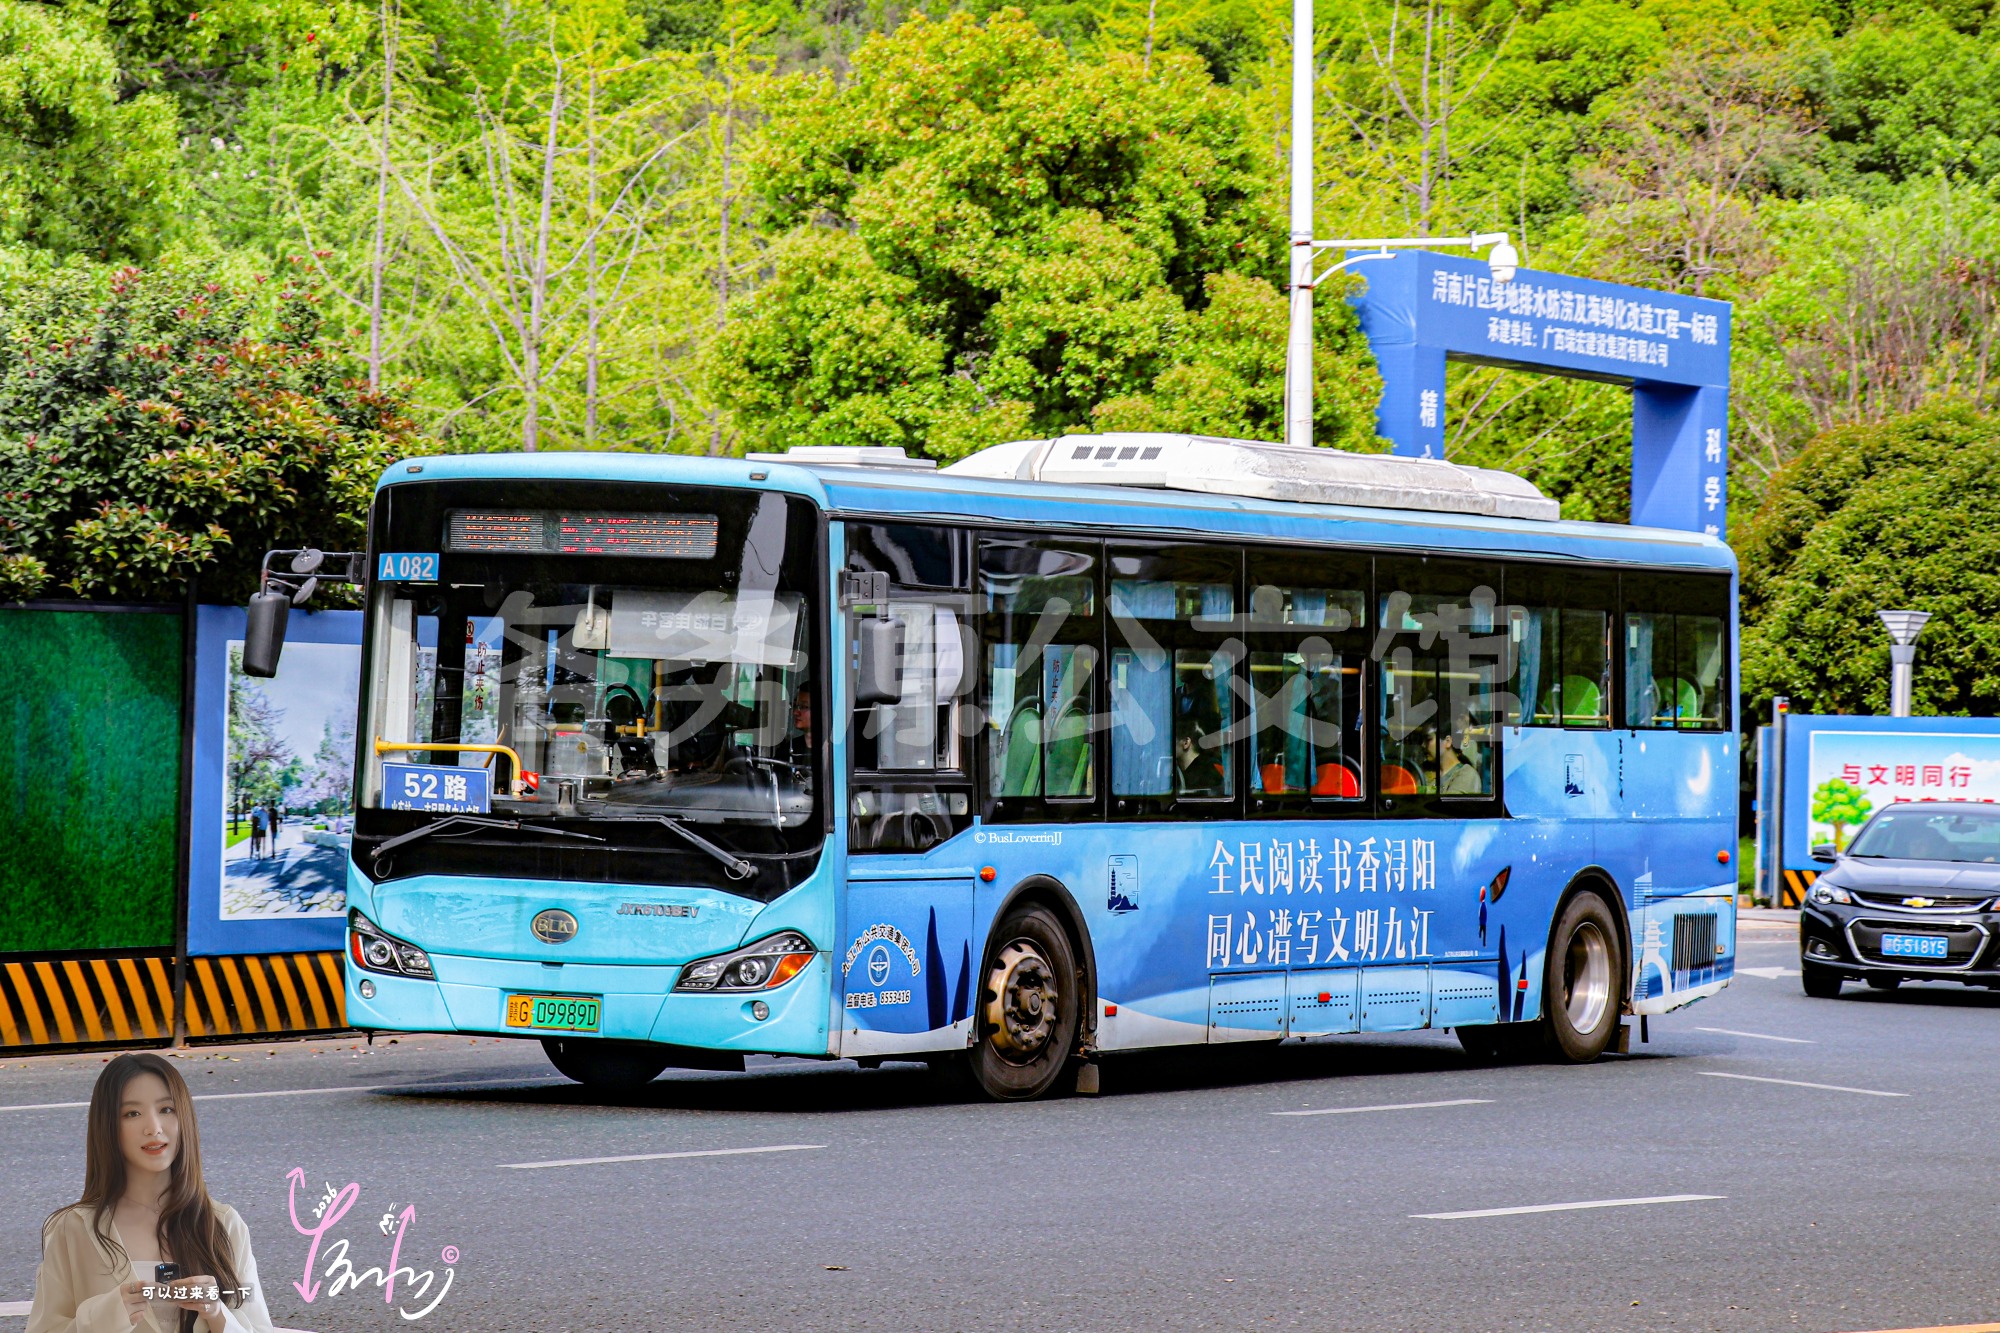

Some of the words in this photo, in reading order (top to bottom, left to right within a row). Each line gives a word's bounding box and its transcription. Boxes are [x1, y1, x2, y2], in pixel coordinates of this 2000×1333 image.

[400, 556, 434, 578] 082
[404, 772, 438, 799] 52
[443, 774, 467, 801] 路
[1841, 763, 1972, 787] 与文明同行
[1208, 836, 1436, 896] 全民阅读书香浔阳
[1206, 906, 1434, 969] 同心谱写文明九江
[879, 990, 911, 1004] 8553416
